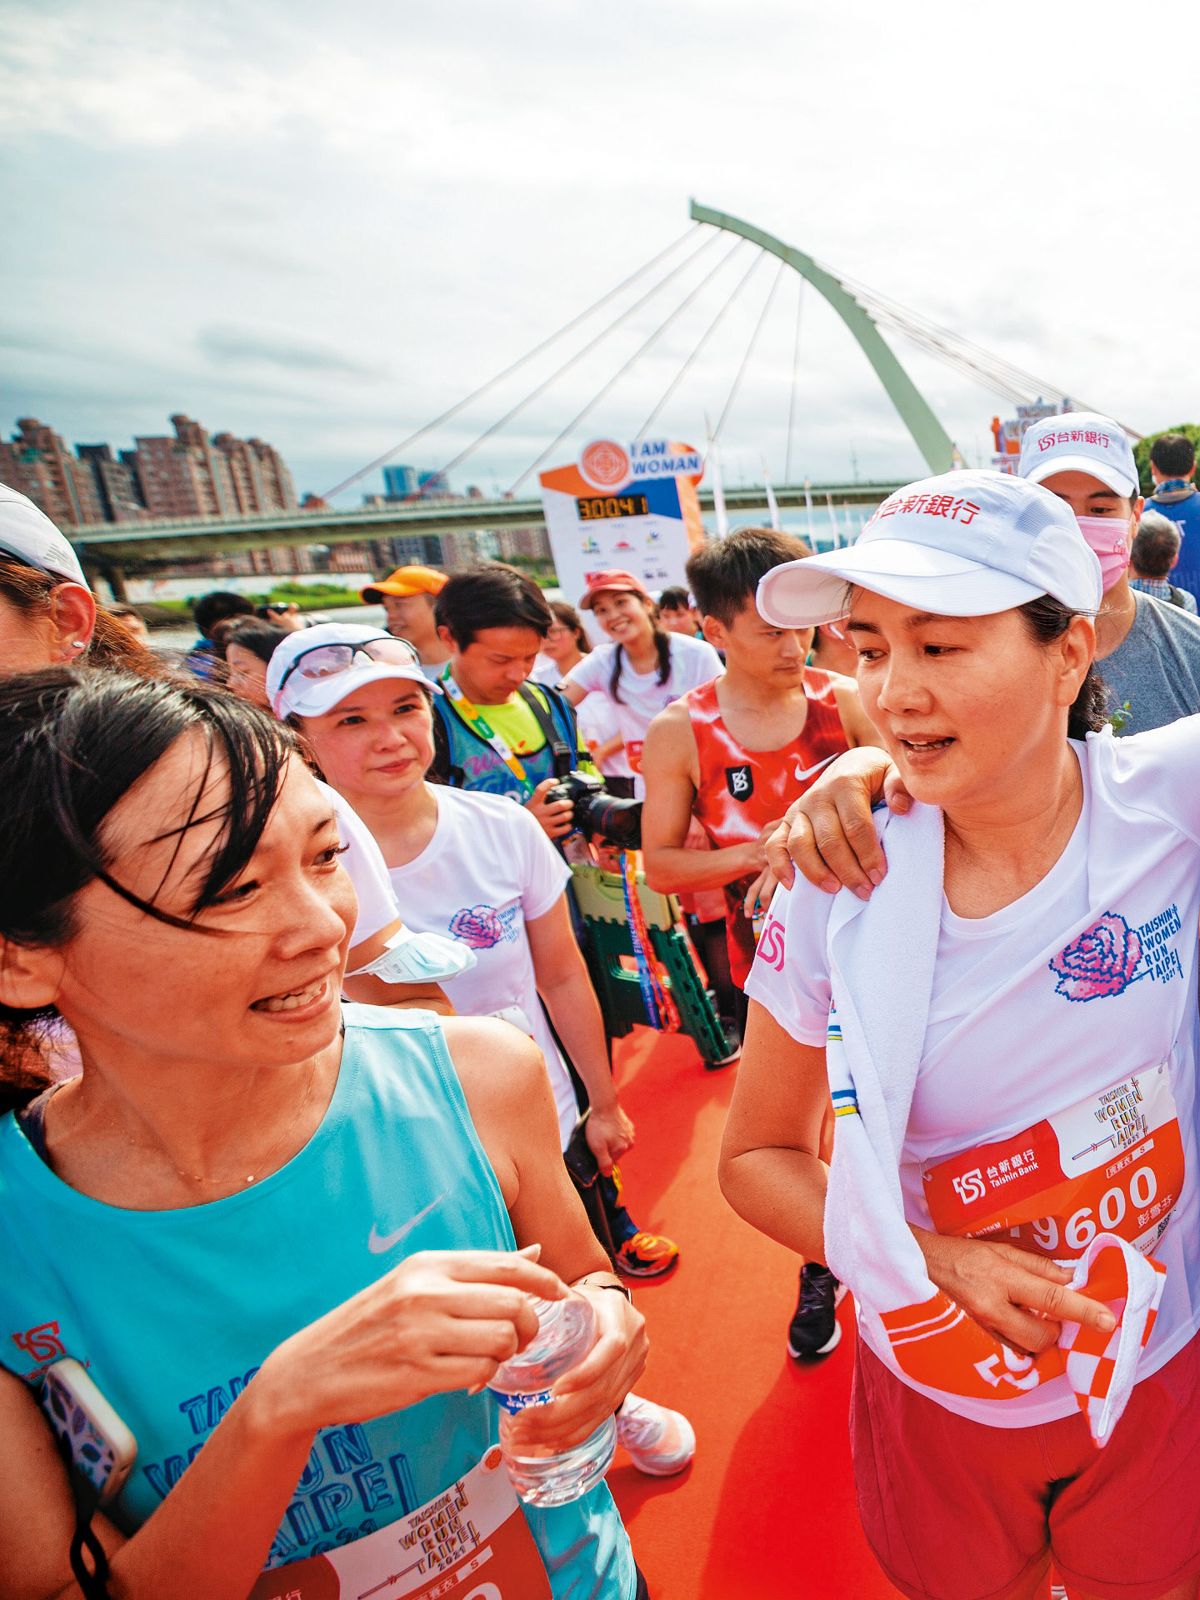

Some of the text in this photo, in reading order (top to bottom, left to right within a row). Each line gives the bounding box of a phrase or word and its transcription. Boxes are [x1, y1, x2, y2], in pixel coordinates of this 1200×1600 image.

[640, 441, 667, 456] AM
[1057, 430, 1109, 448] 台新銀行
[632, 456, 699, 475] WOMAN
[880, 494, 981, 525] 台新銀行
[1139, 908, 1173, 938] TAISHIN
[1144, 914, 1181, 950] WOMEN
[1145, 943, 1168, 967] RUN
[1149, 949, 1183, 981] TAIPEI
[1162, 968, 1176, 984] 2021
[1094, 1090, 1143, 1123] WOMEN
[1098, 1084, 1130, 1106] TAISHIN
[1110, 1106, 1138, 1131] RUN
[1110, 1114, 1148, 1148] TAIPEI
[986, 1149, 1035, 1179] 台新銀行
[990, 1161, 1039, 1188] Taishin Bank
[1010, 1166, 1157, 1250] 9600
[179, 1367, 260, 1435] TAI
[294, 1422, 373, 1495] UN
[399, 1492, 469, 1550] WOMEN
[408, 1493, 451, 1529] TAISHIN
[417, 1520, 480, 1575] TAIPEI
[421, 1515, 462, 1554] RUN
[438, 1545, 467, 1571] 2021
[470, 1559, 479, 1570] S
